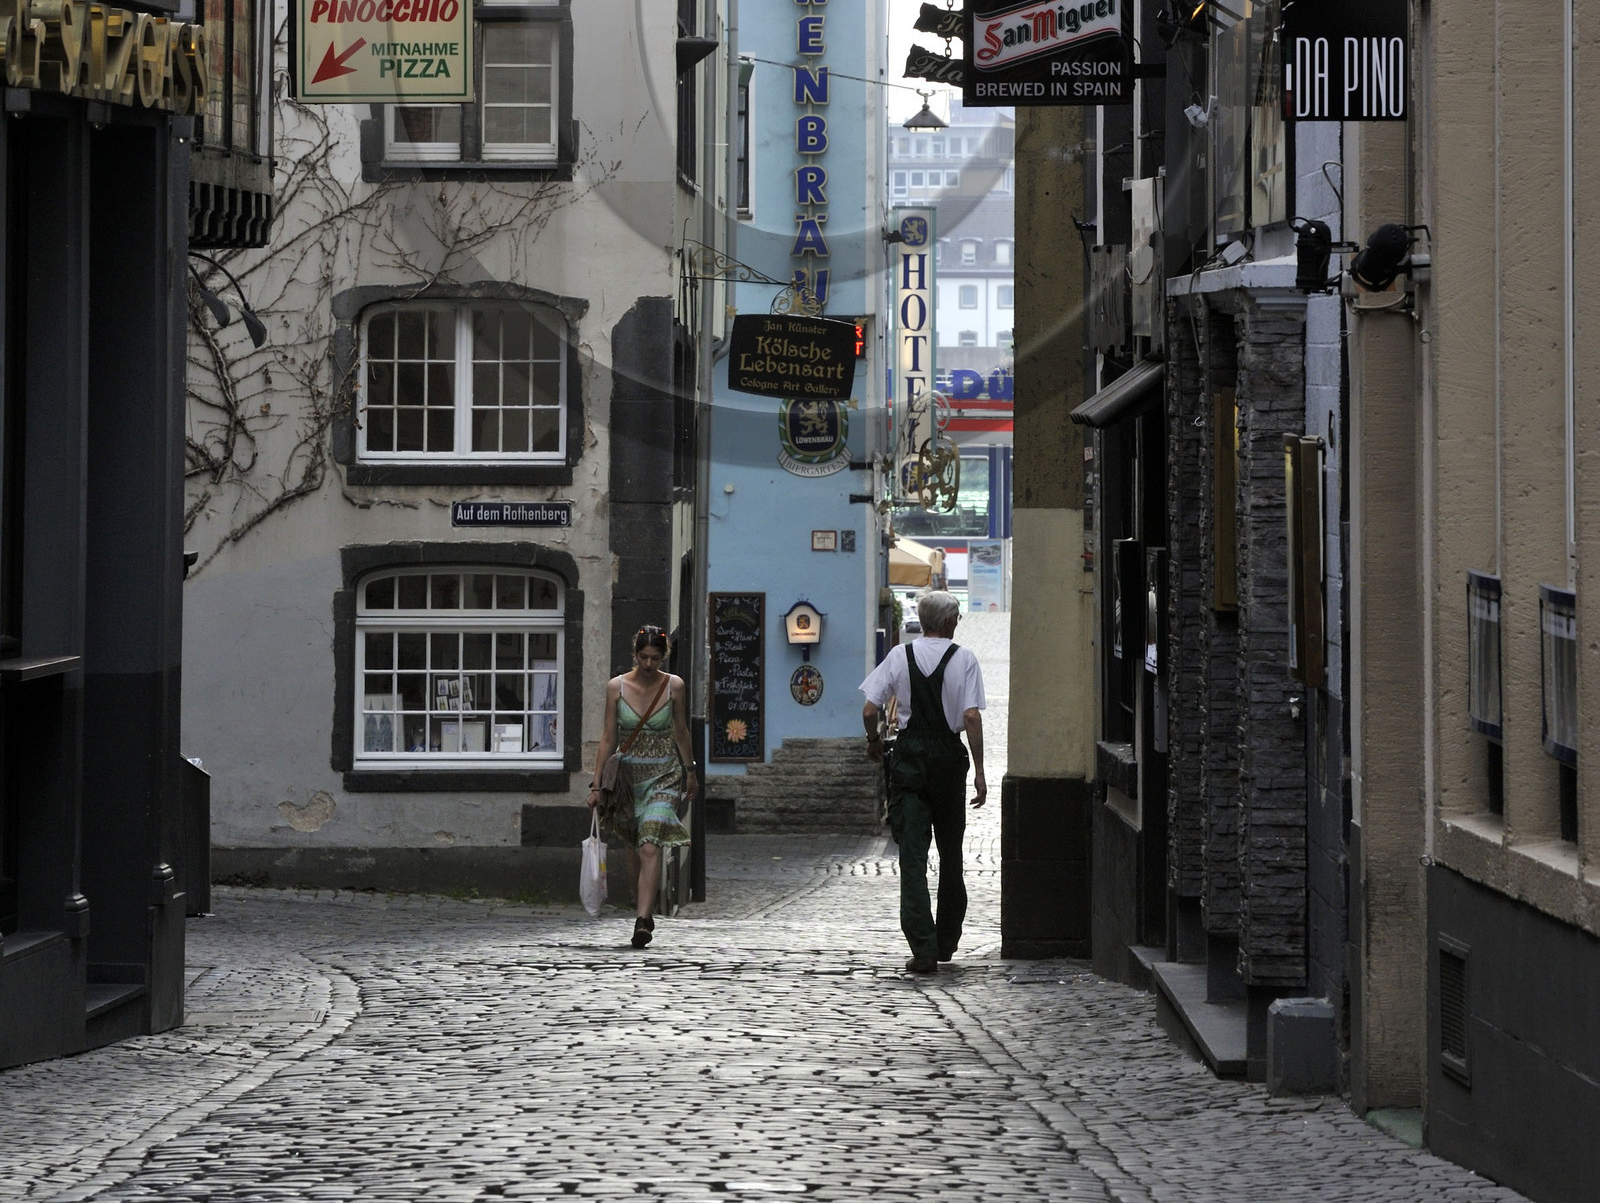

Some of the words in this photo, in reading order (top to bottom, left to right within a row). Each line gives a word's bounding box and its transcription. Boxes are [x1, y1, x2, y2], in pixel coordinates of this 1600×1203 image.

[371, 42, 459, 57] MITNAHME
[380, 58, 451, 79] PIZZA
[1051, 61, 1121, 76] PASSION
[1296, 37, 1329, 117] DA
[1343, 37, 1404, 117] PINO
[976, 82, 1045, 97] BREWED
[1051, 82, 1068, 97] IN
[1073, 82, 1121, 97] SPAIN
[763, 319, 783, 332] Jan
[755, 335, 832, 364] Kölsche
[739, 352, 845, 380] Lebensart
[740, 376, 779, 391] Cologne
[782, 380, 800, 392] Art
[804, 382, 840, 397] Gallery
[785, 457, 845, 476] BIERGARTEN
[456, 504, 474, 521] Auf
[477, 504, 500, 521] dem
[503, 504, 567, 525] Rothenberg
[732, 664, 754, 677] Pasta
